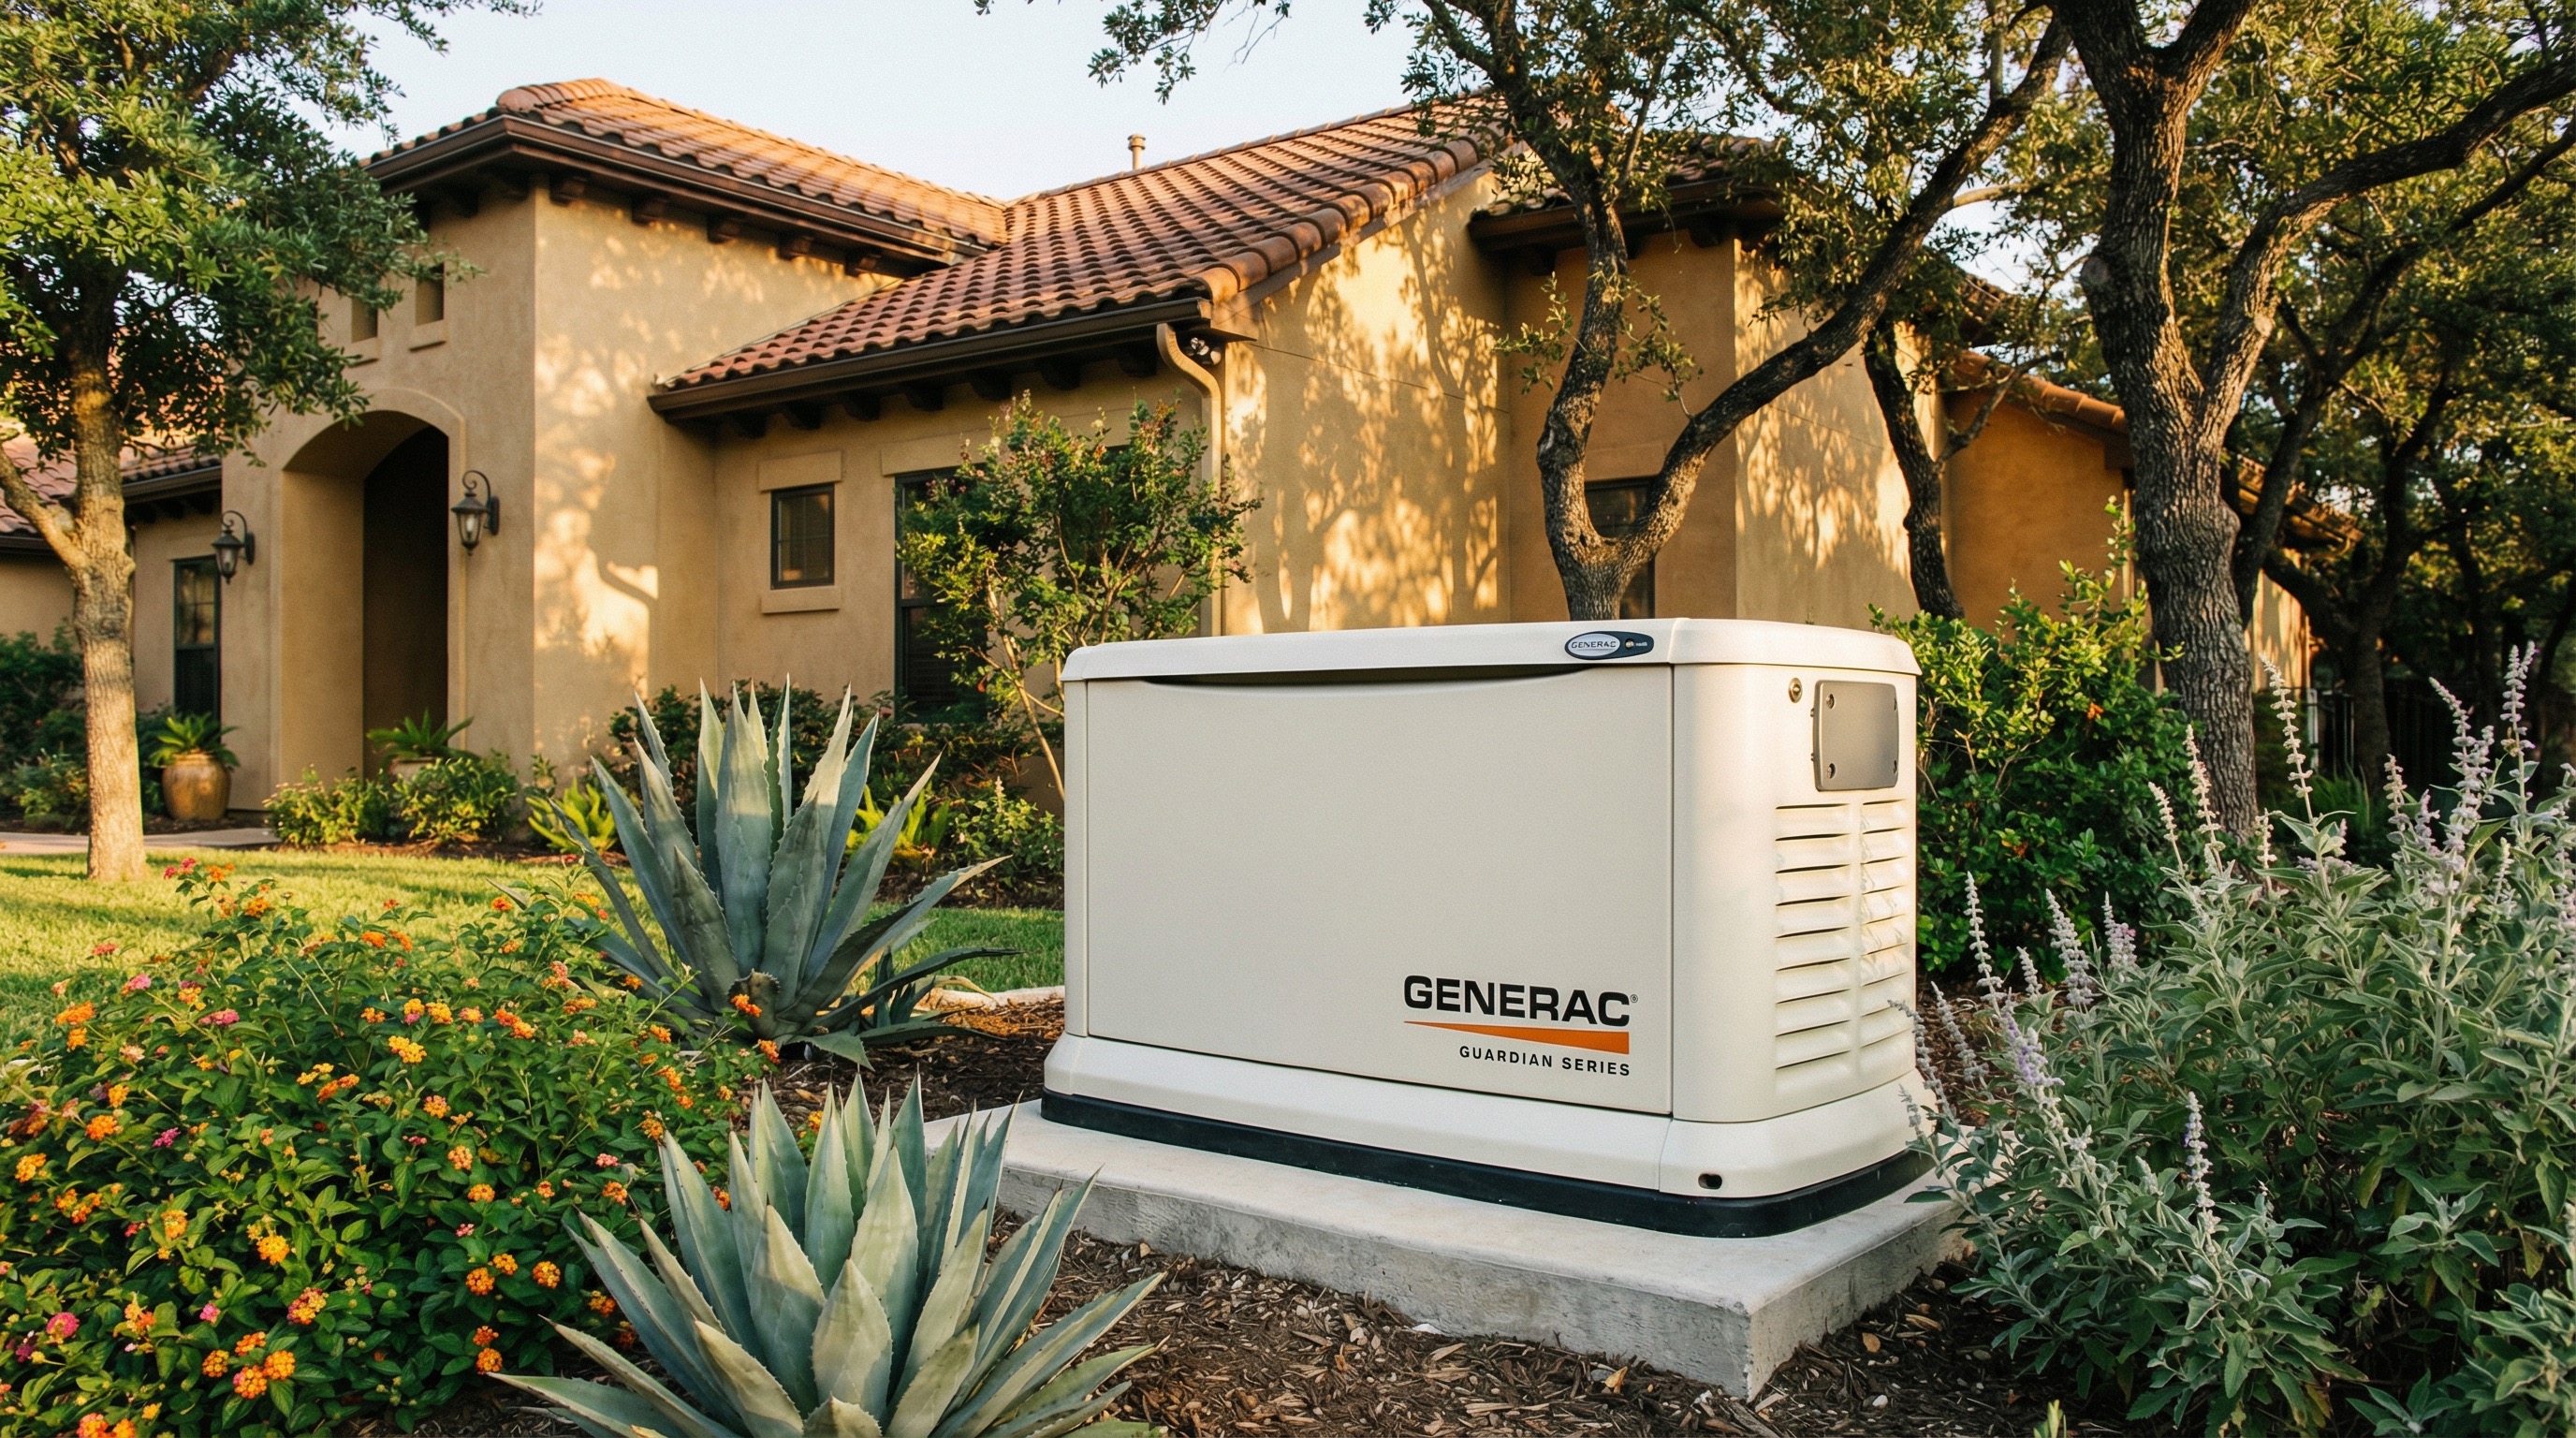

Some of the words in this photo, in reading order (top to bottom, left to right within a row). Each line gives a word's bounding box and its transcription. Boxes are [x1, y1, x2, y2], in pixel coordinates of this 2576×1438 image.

[1572, 640, 1617, 649] GENERAC
[1459, 1046, 1553, 1067] GUARDIAN
[1561, 1057, 1630, 1076] SERIES
